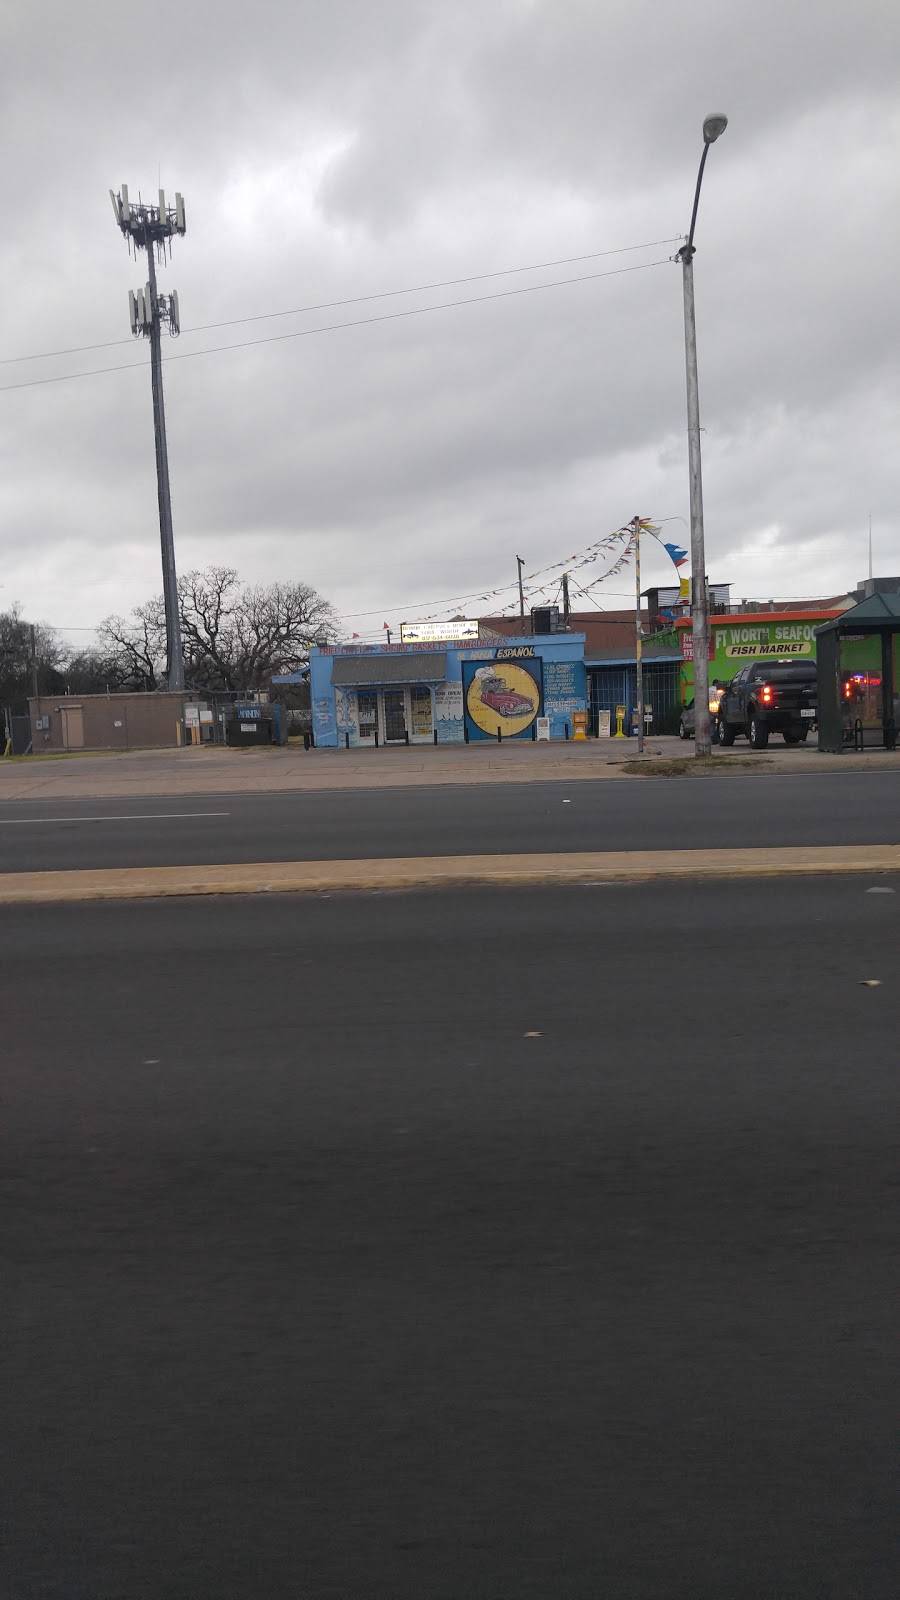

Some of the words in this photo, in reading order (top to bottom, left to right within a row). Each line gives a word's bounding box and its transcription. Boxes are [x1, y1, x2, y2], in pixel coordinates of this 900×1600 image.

[715, 630, 728, 648] FT
[730, 628, 770, 644] WORTH
[496, 646, 536, 658] ESPAÑOL
[731, 646, 756, 656] FISH
[759, 644, 804, 654] MARKET
